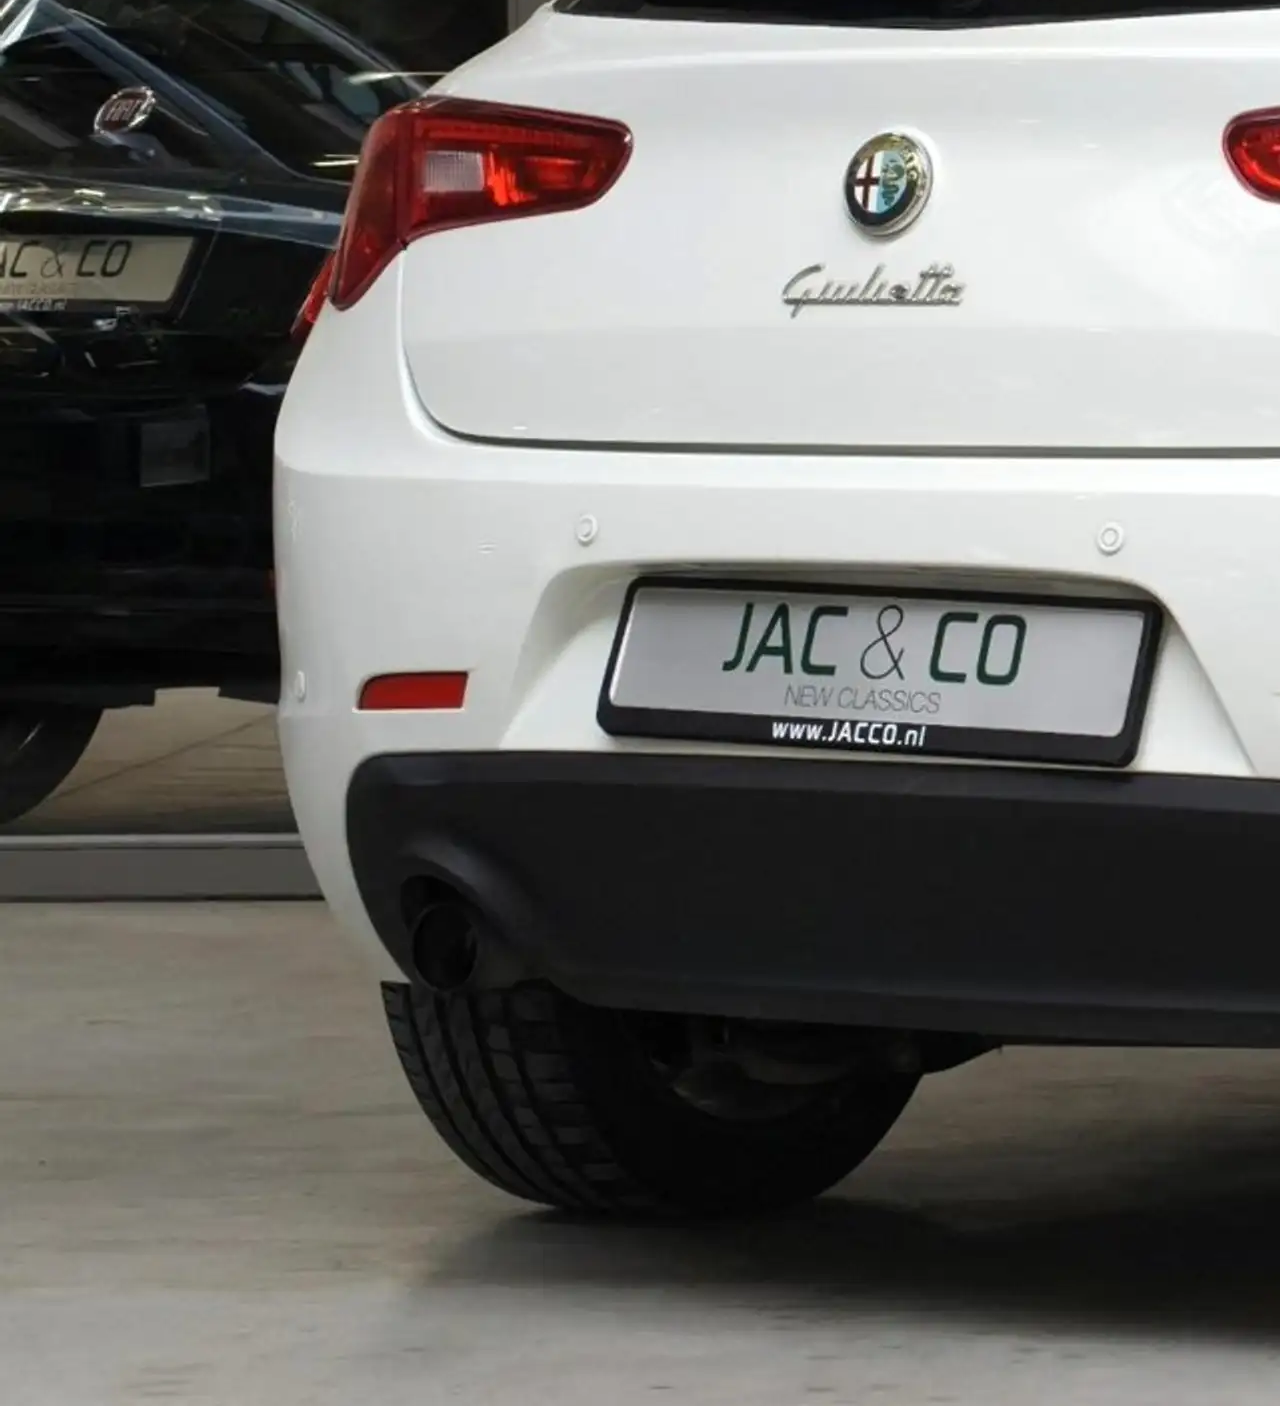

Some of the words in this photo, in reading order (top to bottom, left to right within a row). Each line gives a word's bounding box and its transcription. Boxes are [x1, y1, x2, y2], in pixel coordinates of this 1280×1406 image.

[76, 239, 133, 278] CO
[782, 261, 966, 319] Giulietta
[722, 602, 849, 676] JAC
[859, 604, 905, 680] &
[929, 612, 1027, 686] CO
[783, 684, 832, 708] NEW
[836, 686, 942, 714] CLASSICS
[771, 720, 927, 748] www.JACCO.nl
